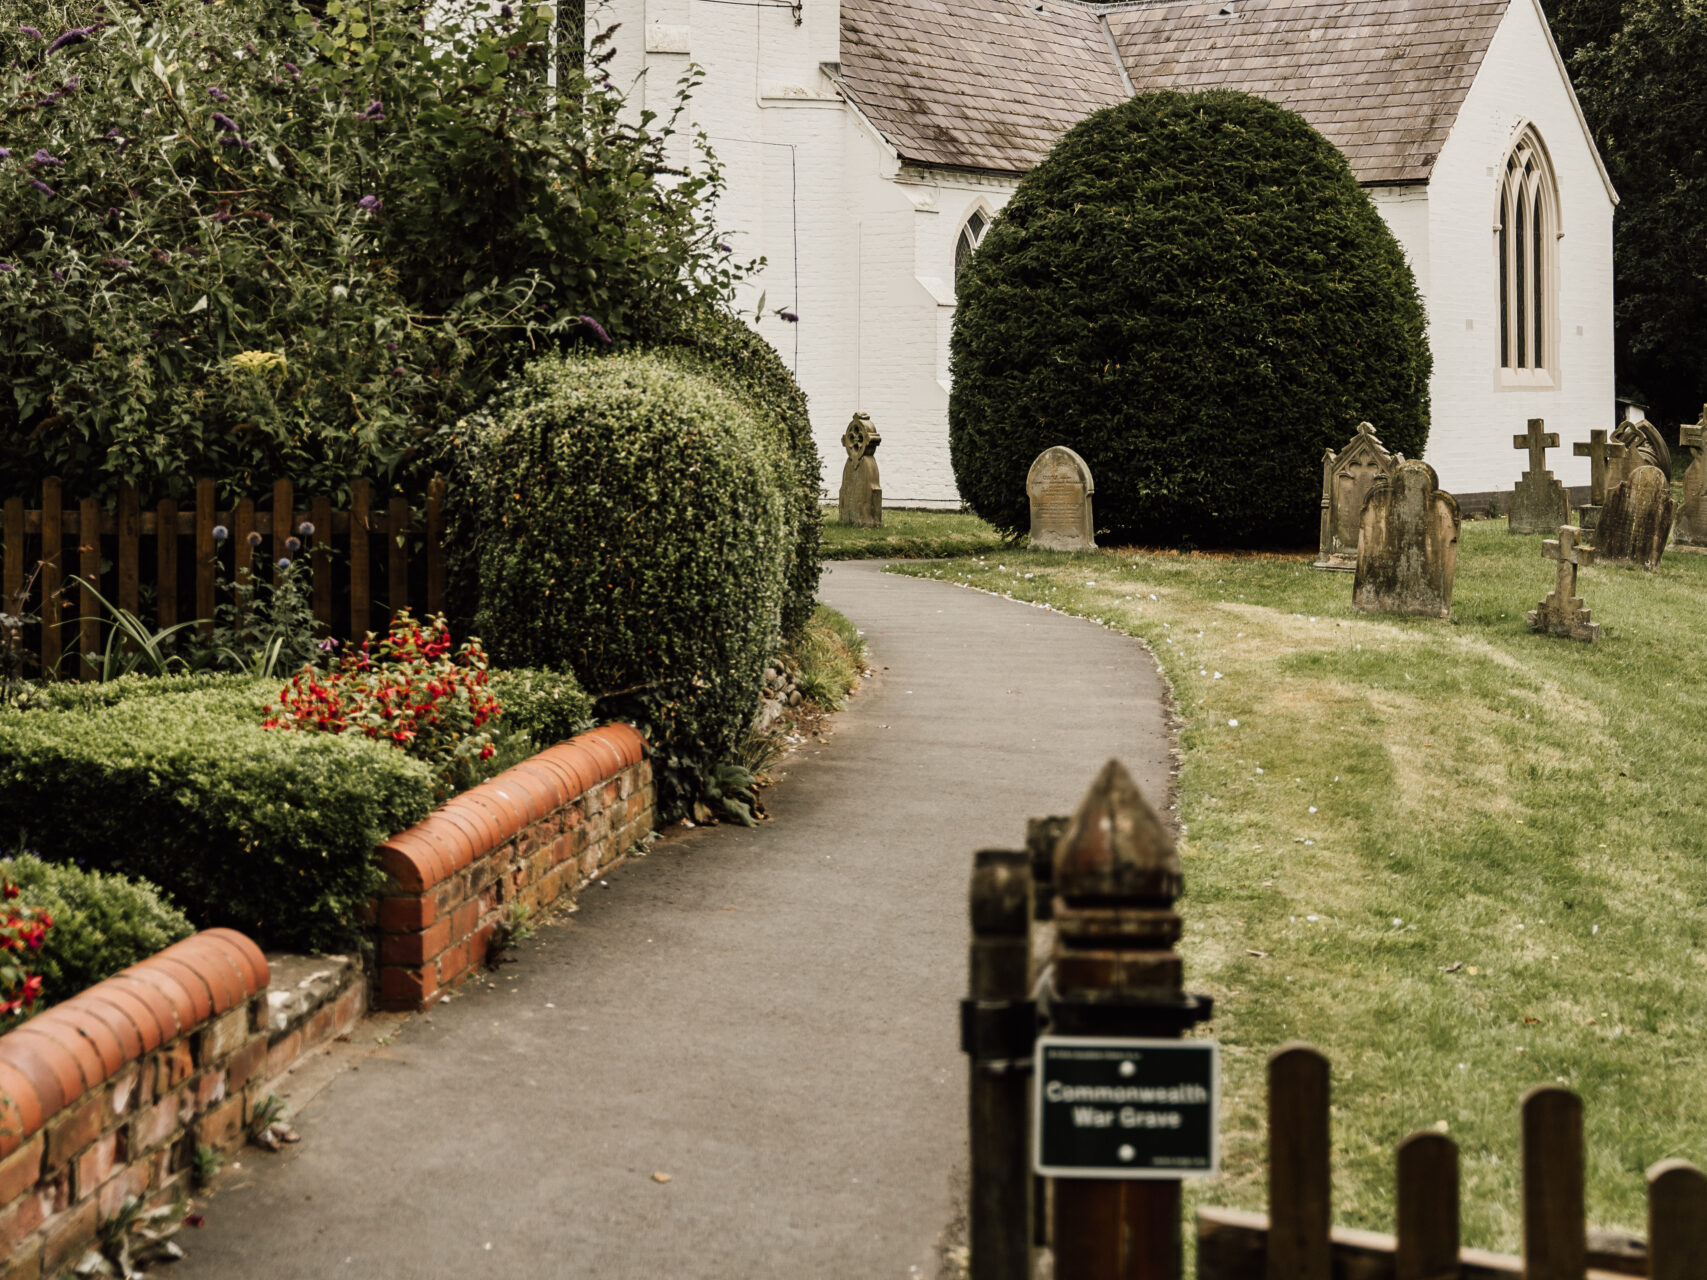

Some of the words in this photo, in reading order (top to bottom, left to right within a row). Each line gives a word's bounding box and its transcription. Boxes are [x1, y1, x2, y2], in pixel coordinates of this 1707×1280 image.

[1046, 1081, 1207, 1104] Commonwealth
[1073, 1107, 1114, 1128] War
[1119, 1107, 1181, 1129] Grave
